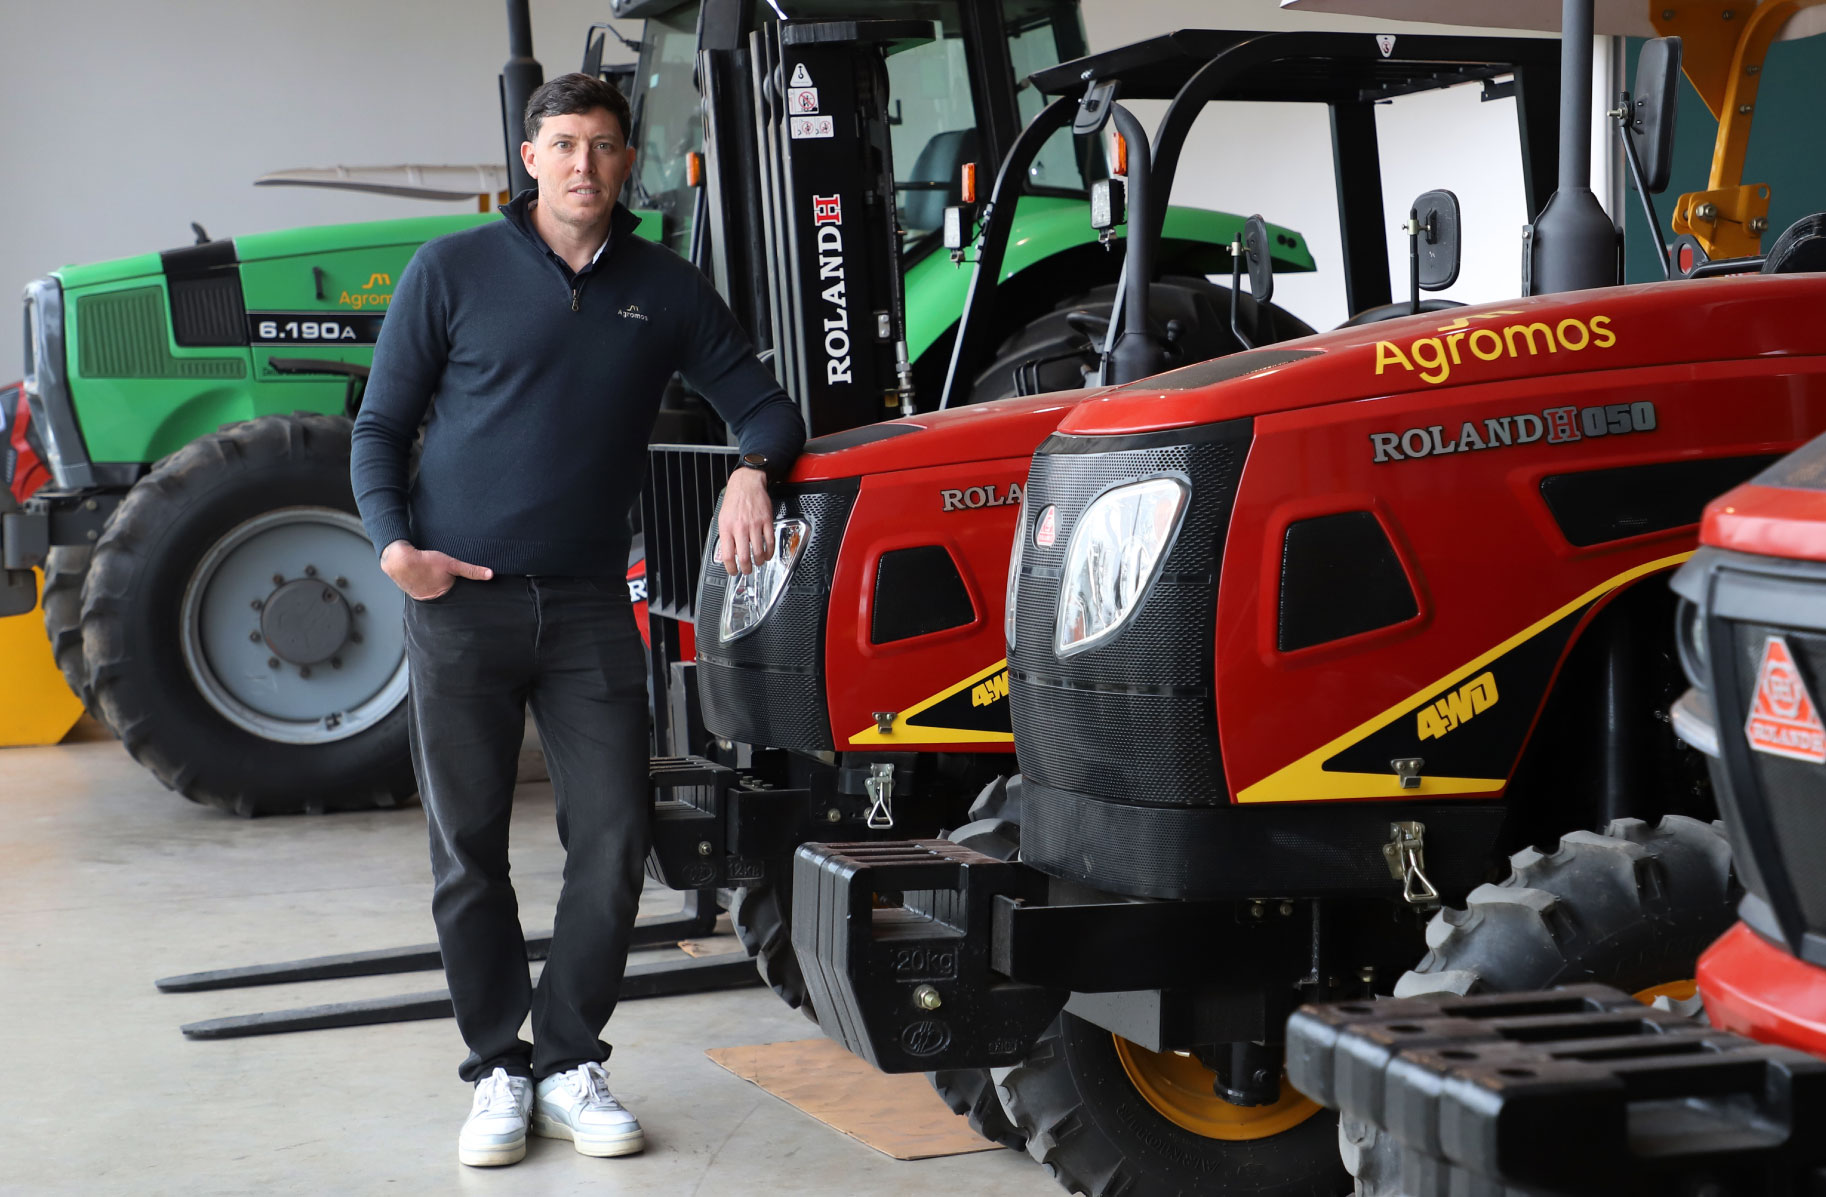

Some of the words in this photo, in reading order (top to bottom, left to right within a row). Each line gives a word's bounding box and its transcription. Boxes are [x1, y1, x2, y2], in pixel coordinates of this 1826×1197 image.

[617, 309, 649, 321] Agromos
[812, 193, 852, 386] ROLANDH
[1375, 315, 1617, 384] Agromos
[1417, 671, 1499, 742] 4WD
[897, 948, 953, 974] 20kg
